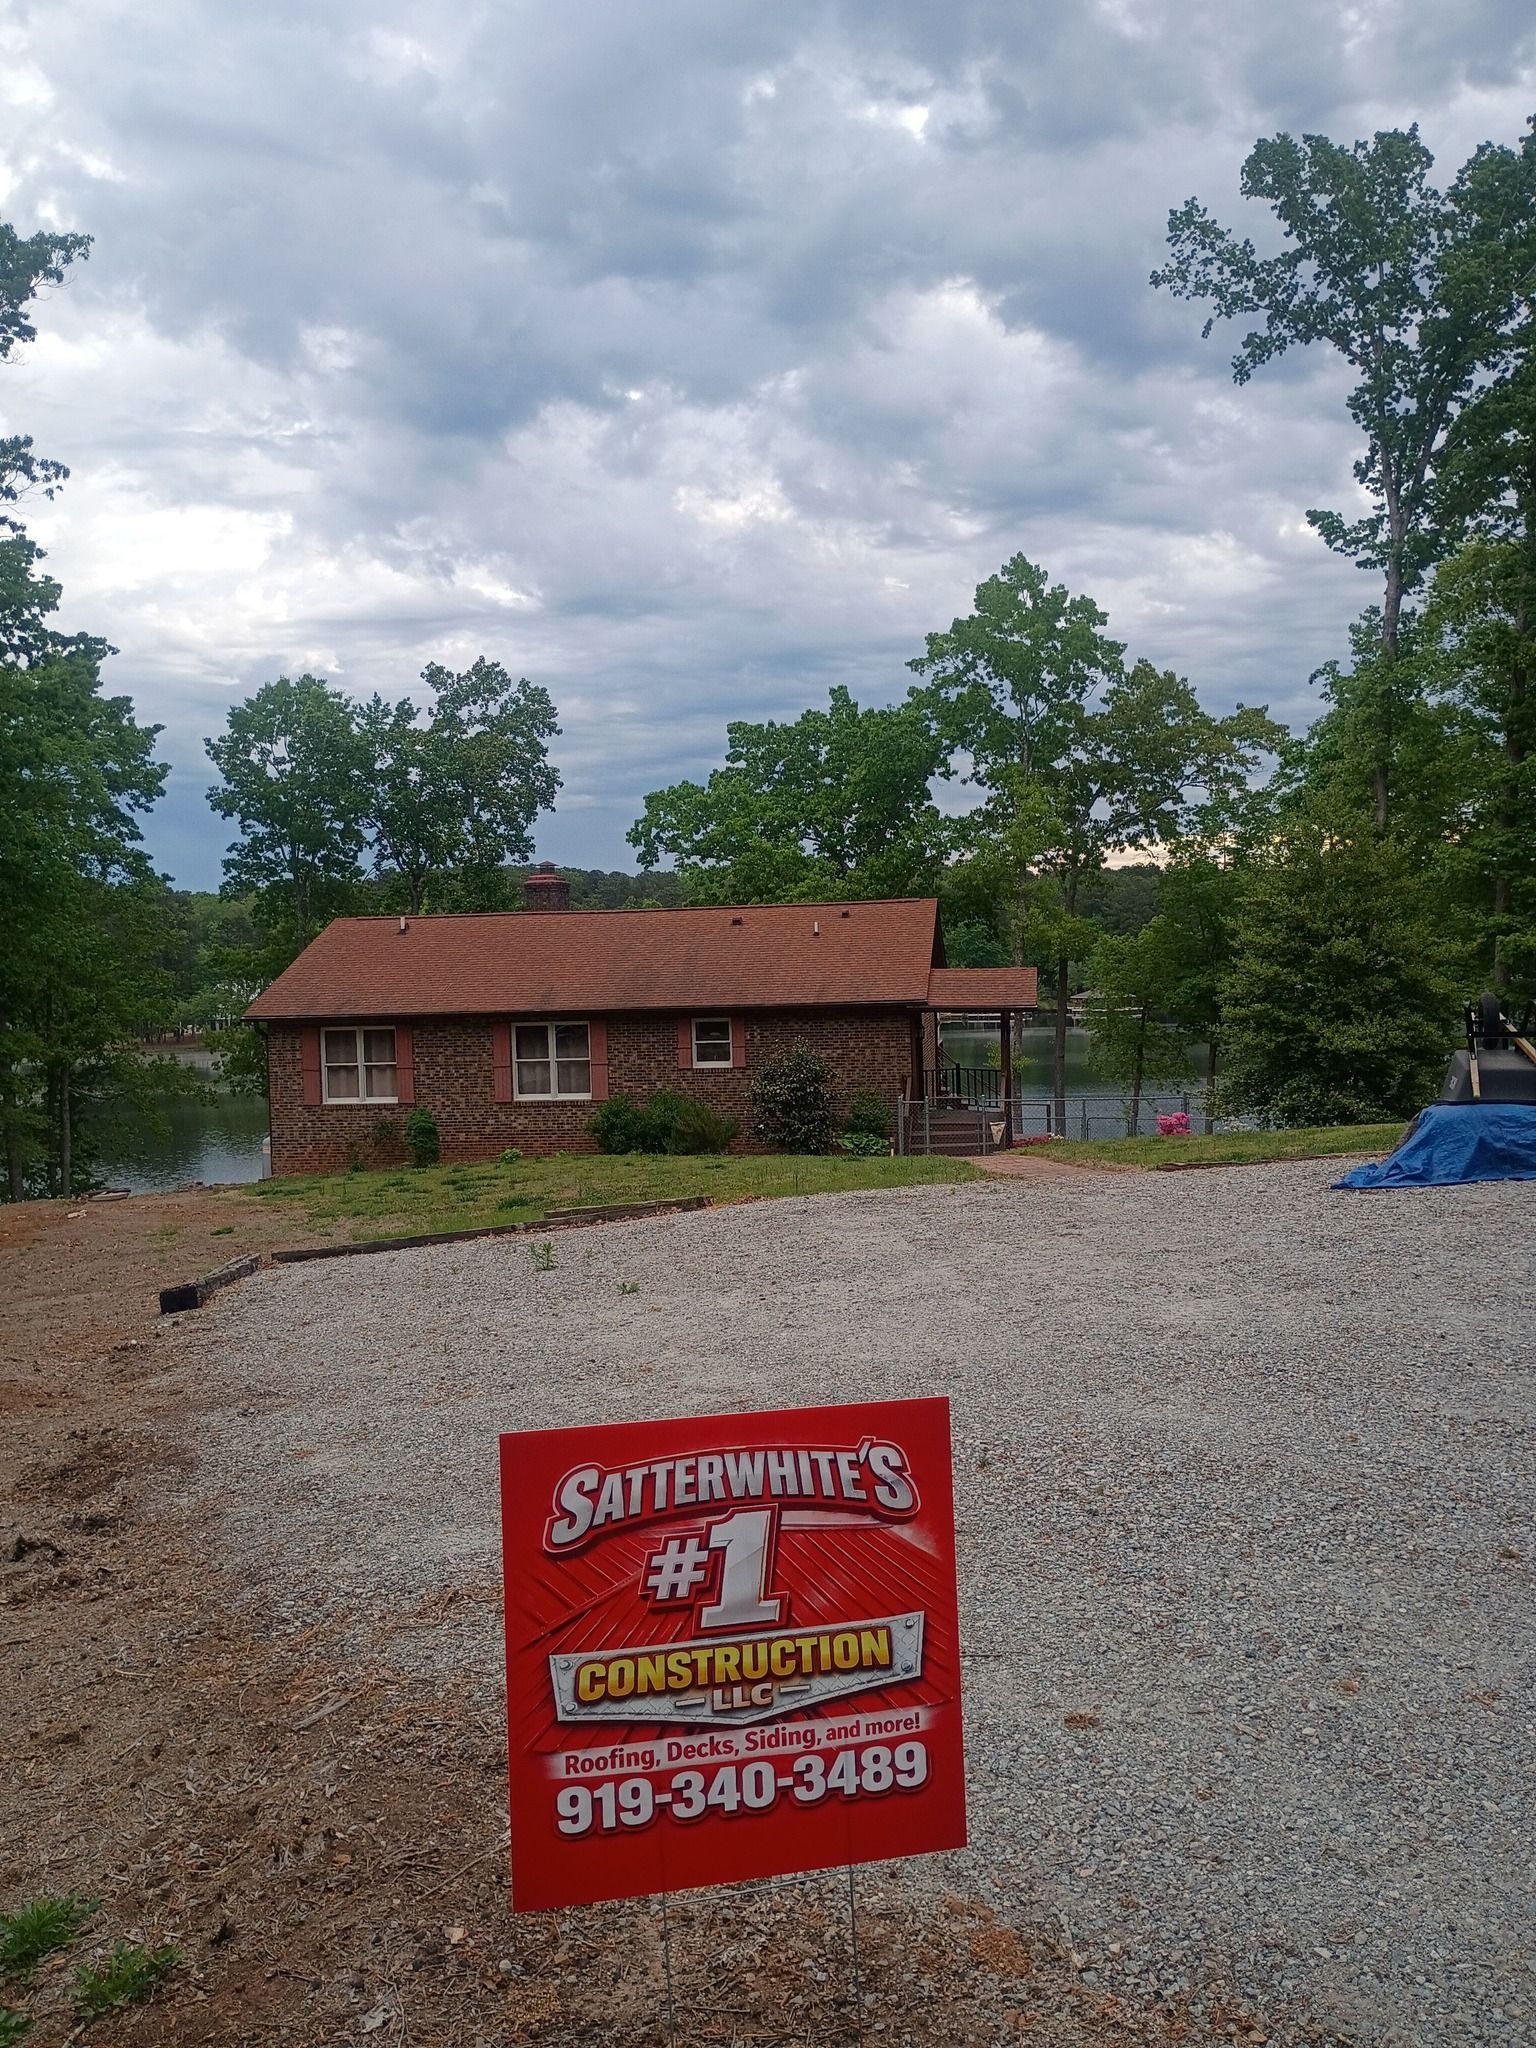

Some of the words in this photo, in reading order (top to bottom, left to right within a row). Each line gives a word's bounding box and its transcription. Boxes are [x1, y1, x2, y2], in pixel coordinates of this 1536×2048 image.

[550, 1439, 915, 1545] SATTERWHITE'S
[645, 1508, 780, 1628] #1
[578, 1629, 890, 1701] CONSTRUCTION
[713, 1682, 773, 1712] LLC
[565, 1748, 661, 1775] Roofing,
[667, 1735, 741, 1762] Decks,
[745, 1723, 822, 1753] Siding,
[826, 1717, 860, 1741] and
[865, 1711, 921, 1733] more!
[556, 1741, 927, 1835] 919-340-3489
